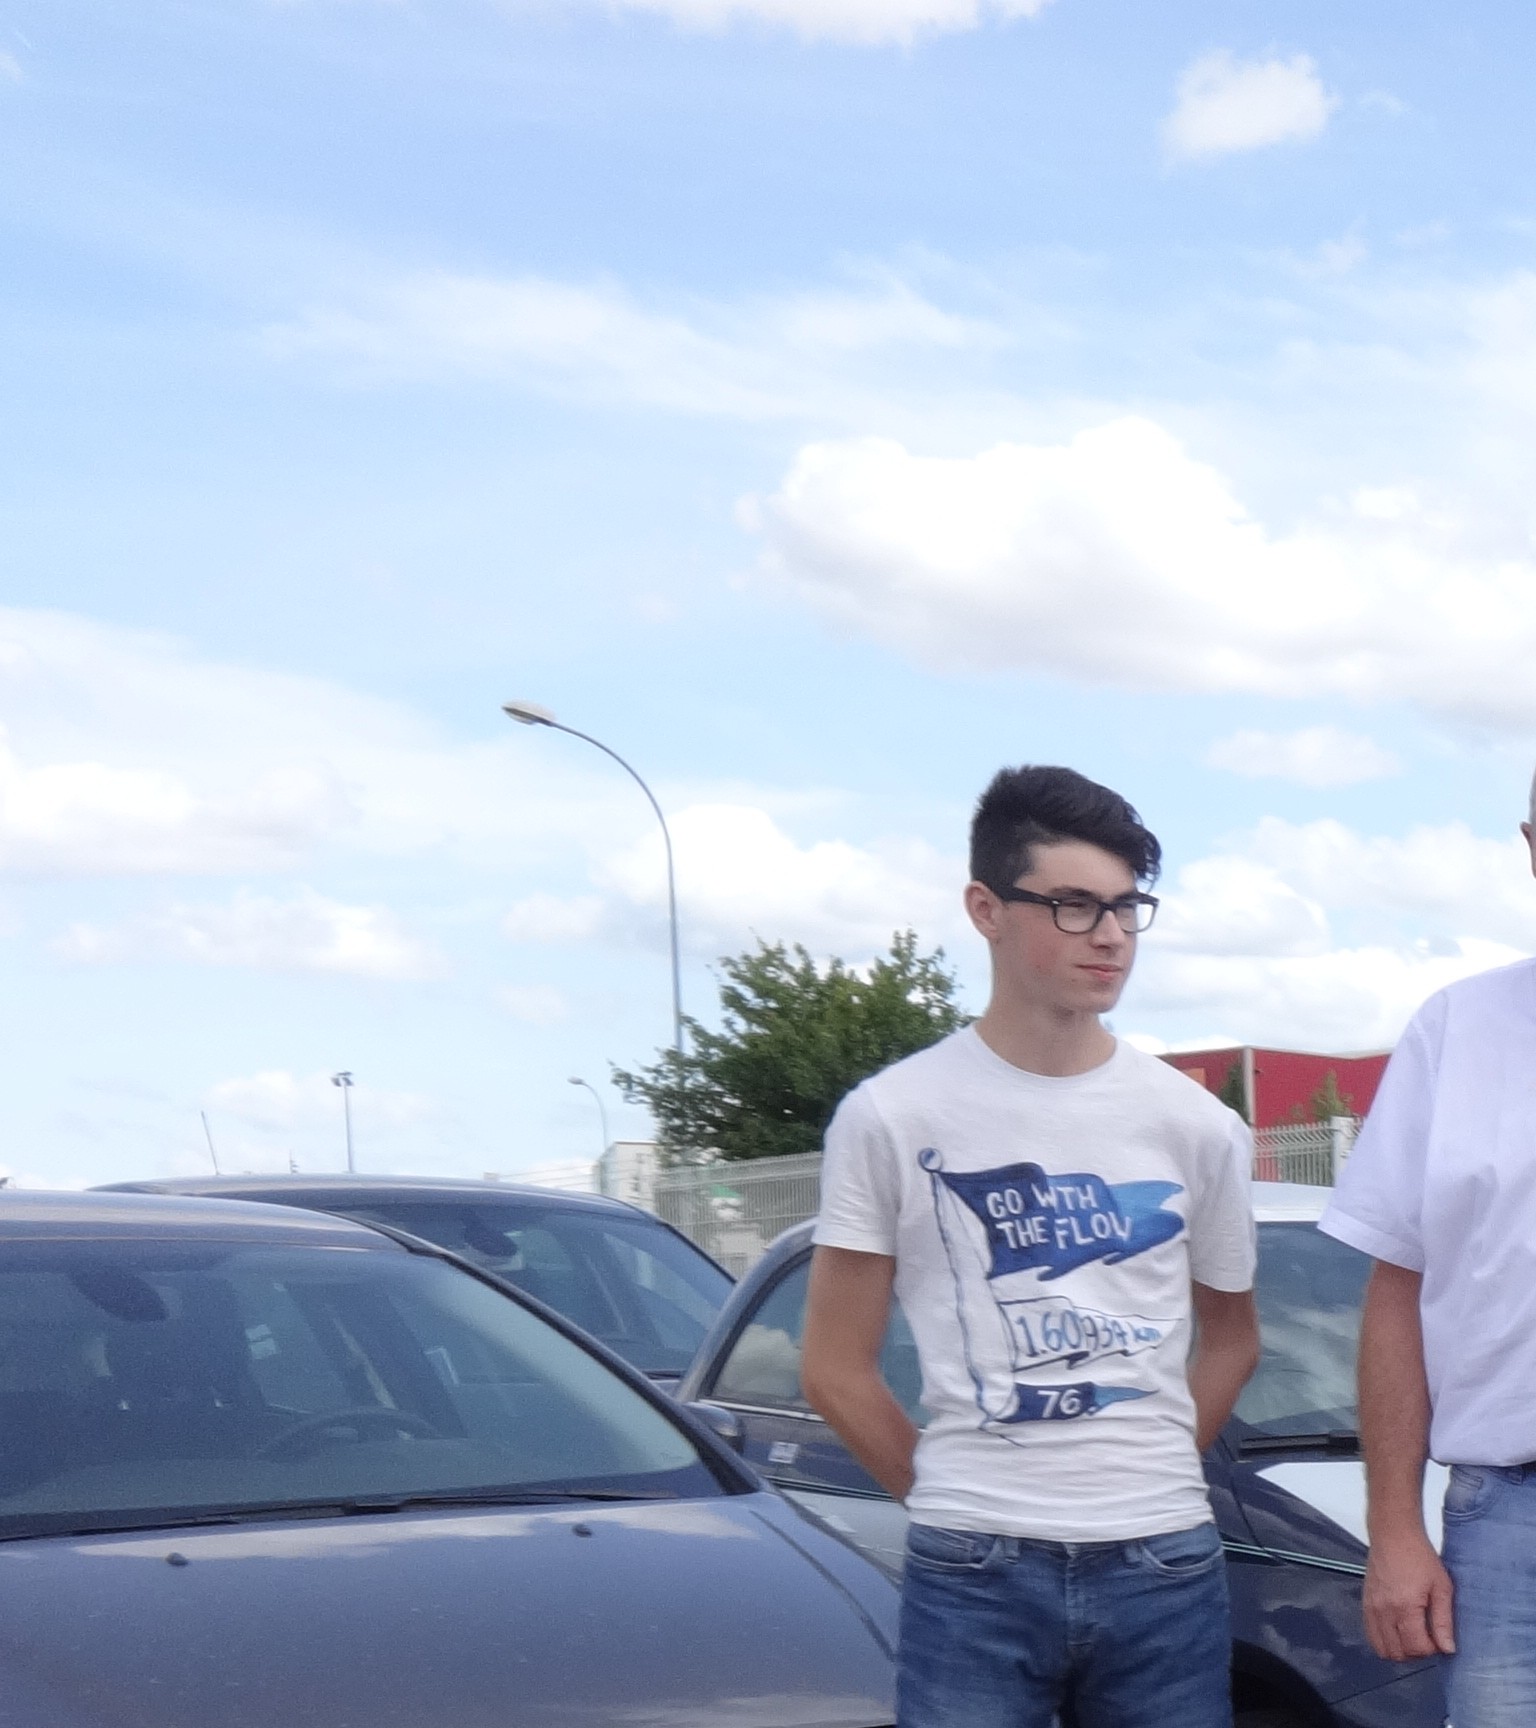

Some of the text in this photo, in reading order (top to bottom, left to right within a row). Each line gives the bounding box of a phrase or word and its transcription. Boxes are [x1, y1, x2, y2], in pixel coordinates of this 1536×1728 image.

[986, 1188, 1025, 1219] GO
[996, 1216, 1050, 1249] THE
[1037, 1388, 1082, 1418] 76
